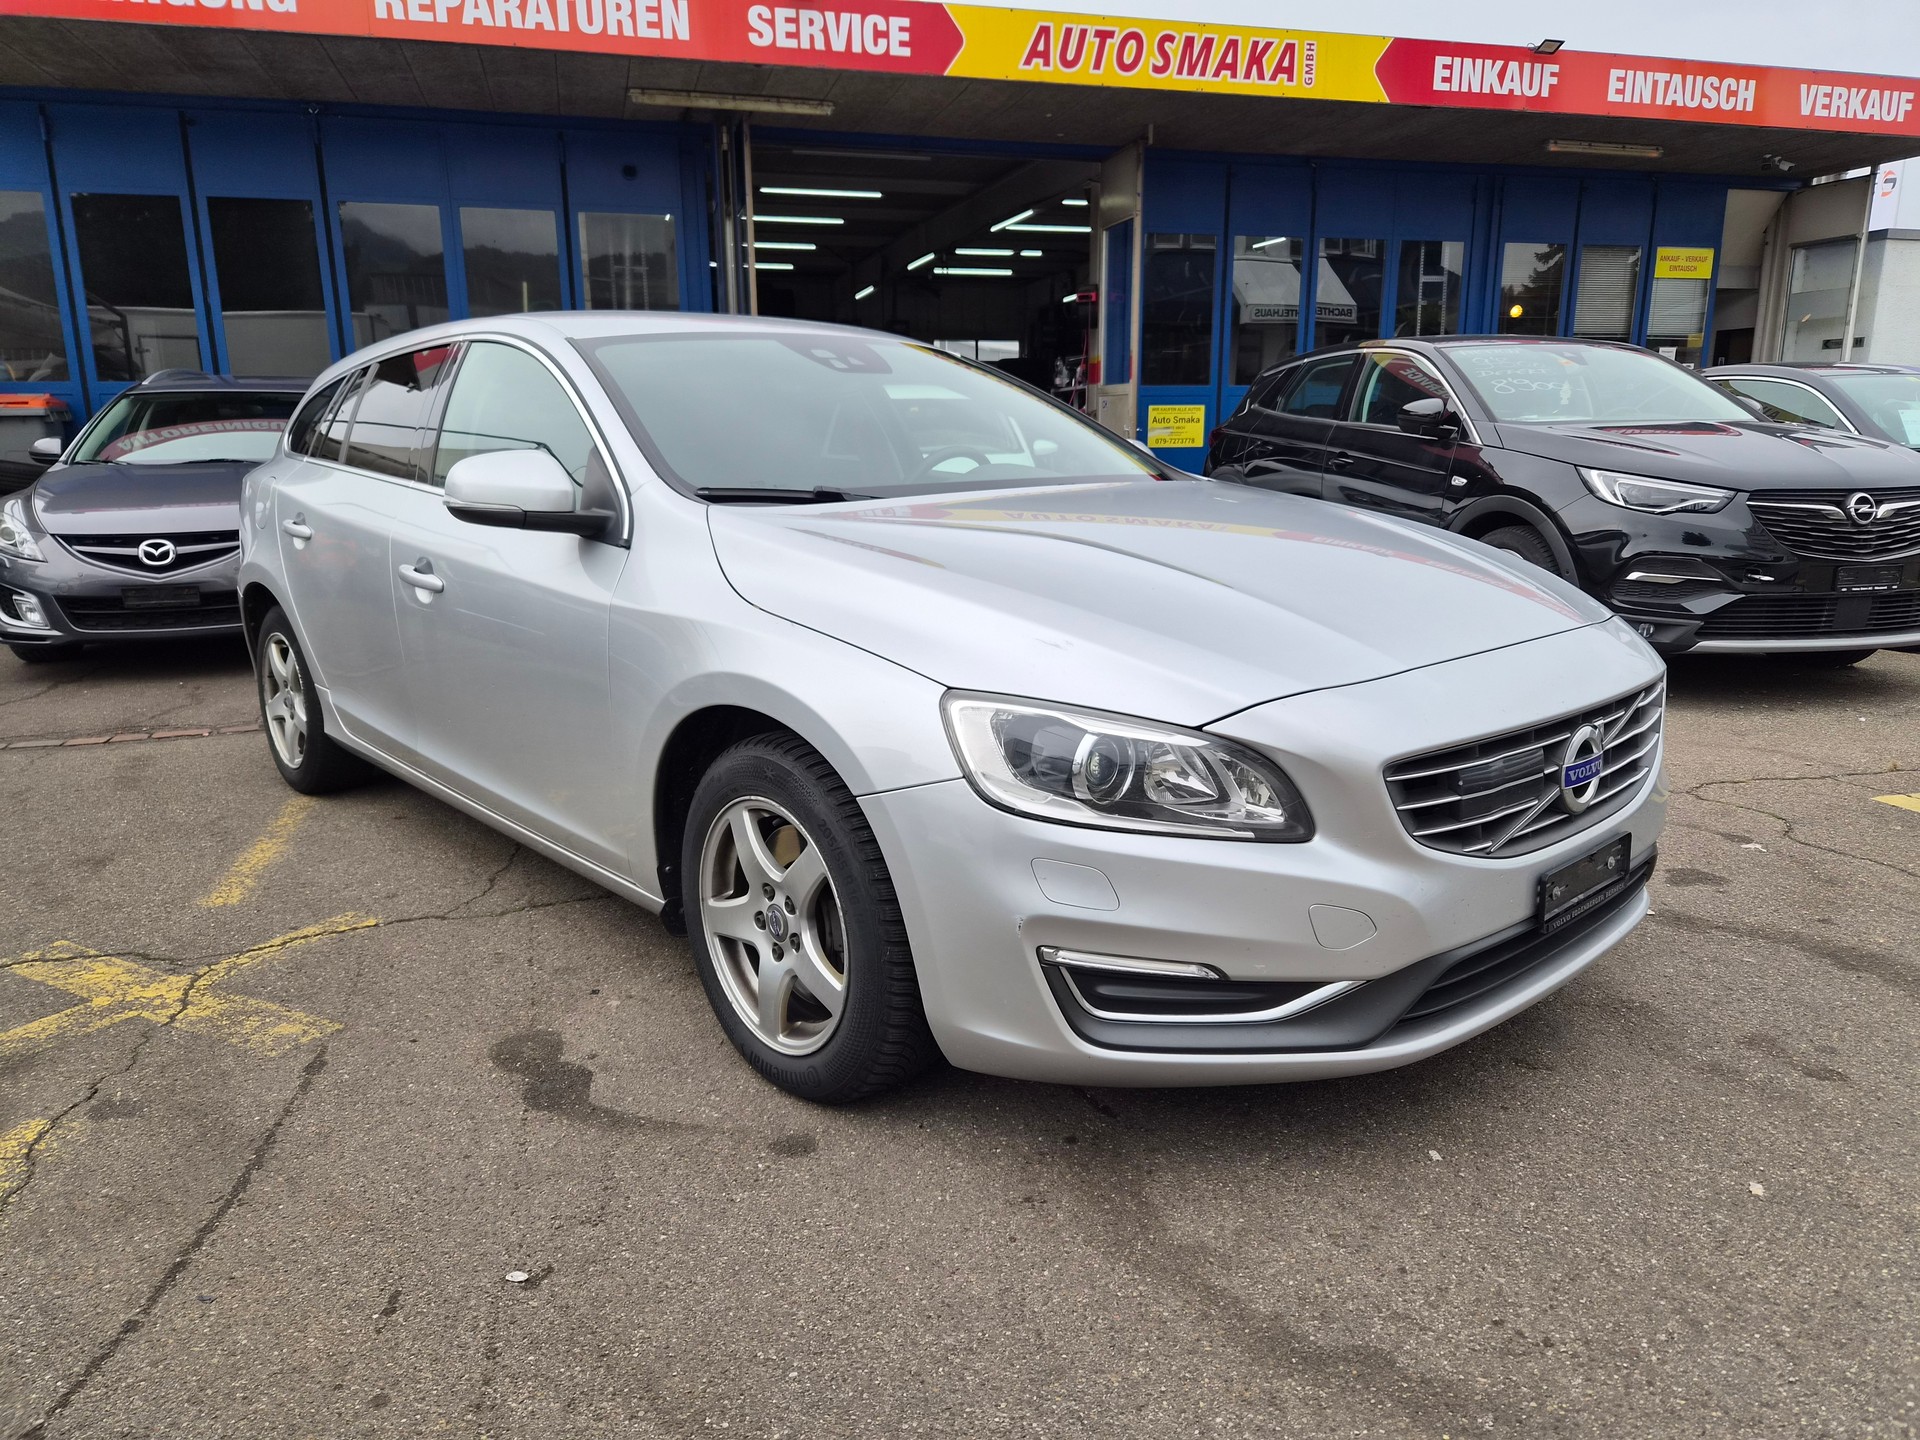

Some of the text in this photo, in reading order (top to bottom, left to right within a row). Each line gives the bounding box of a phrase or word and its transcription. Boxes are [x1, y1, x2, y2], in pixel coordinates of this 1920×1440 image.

[747, 5, 912, 57] SERVICE
[1021, 23, 1297, 84] AUTO SMAKA
[1303, 41, 1315, 87] GMBH
[1432, 55, 1560, 98] EINKAUF
[1607, 68, 1757, 112] EINTAUSCH
[1800, 83, 1915, 123] VERKAUF
[1685, 255, 1709, 263] VERKAUF
[1152, 416, 1200, 424] Auto Smaka
